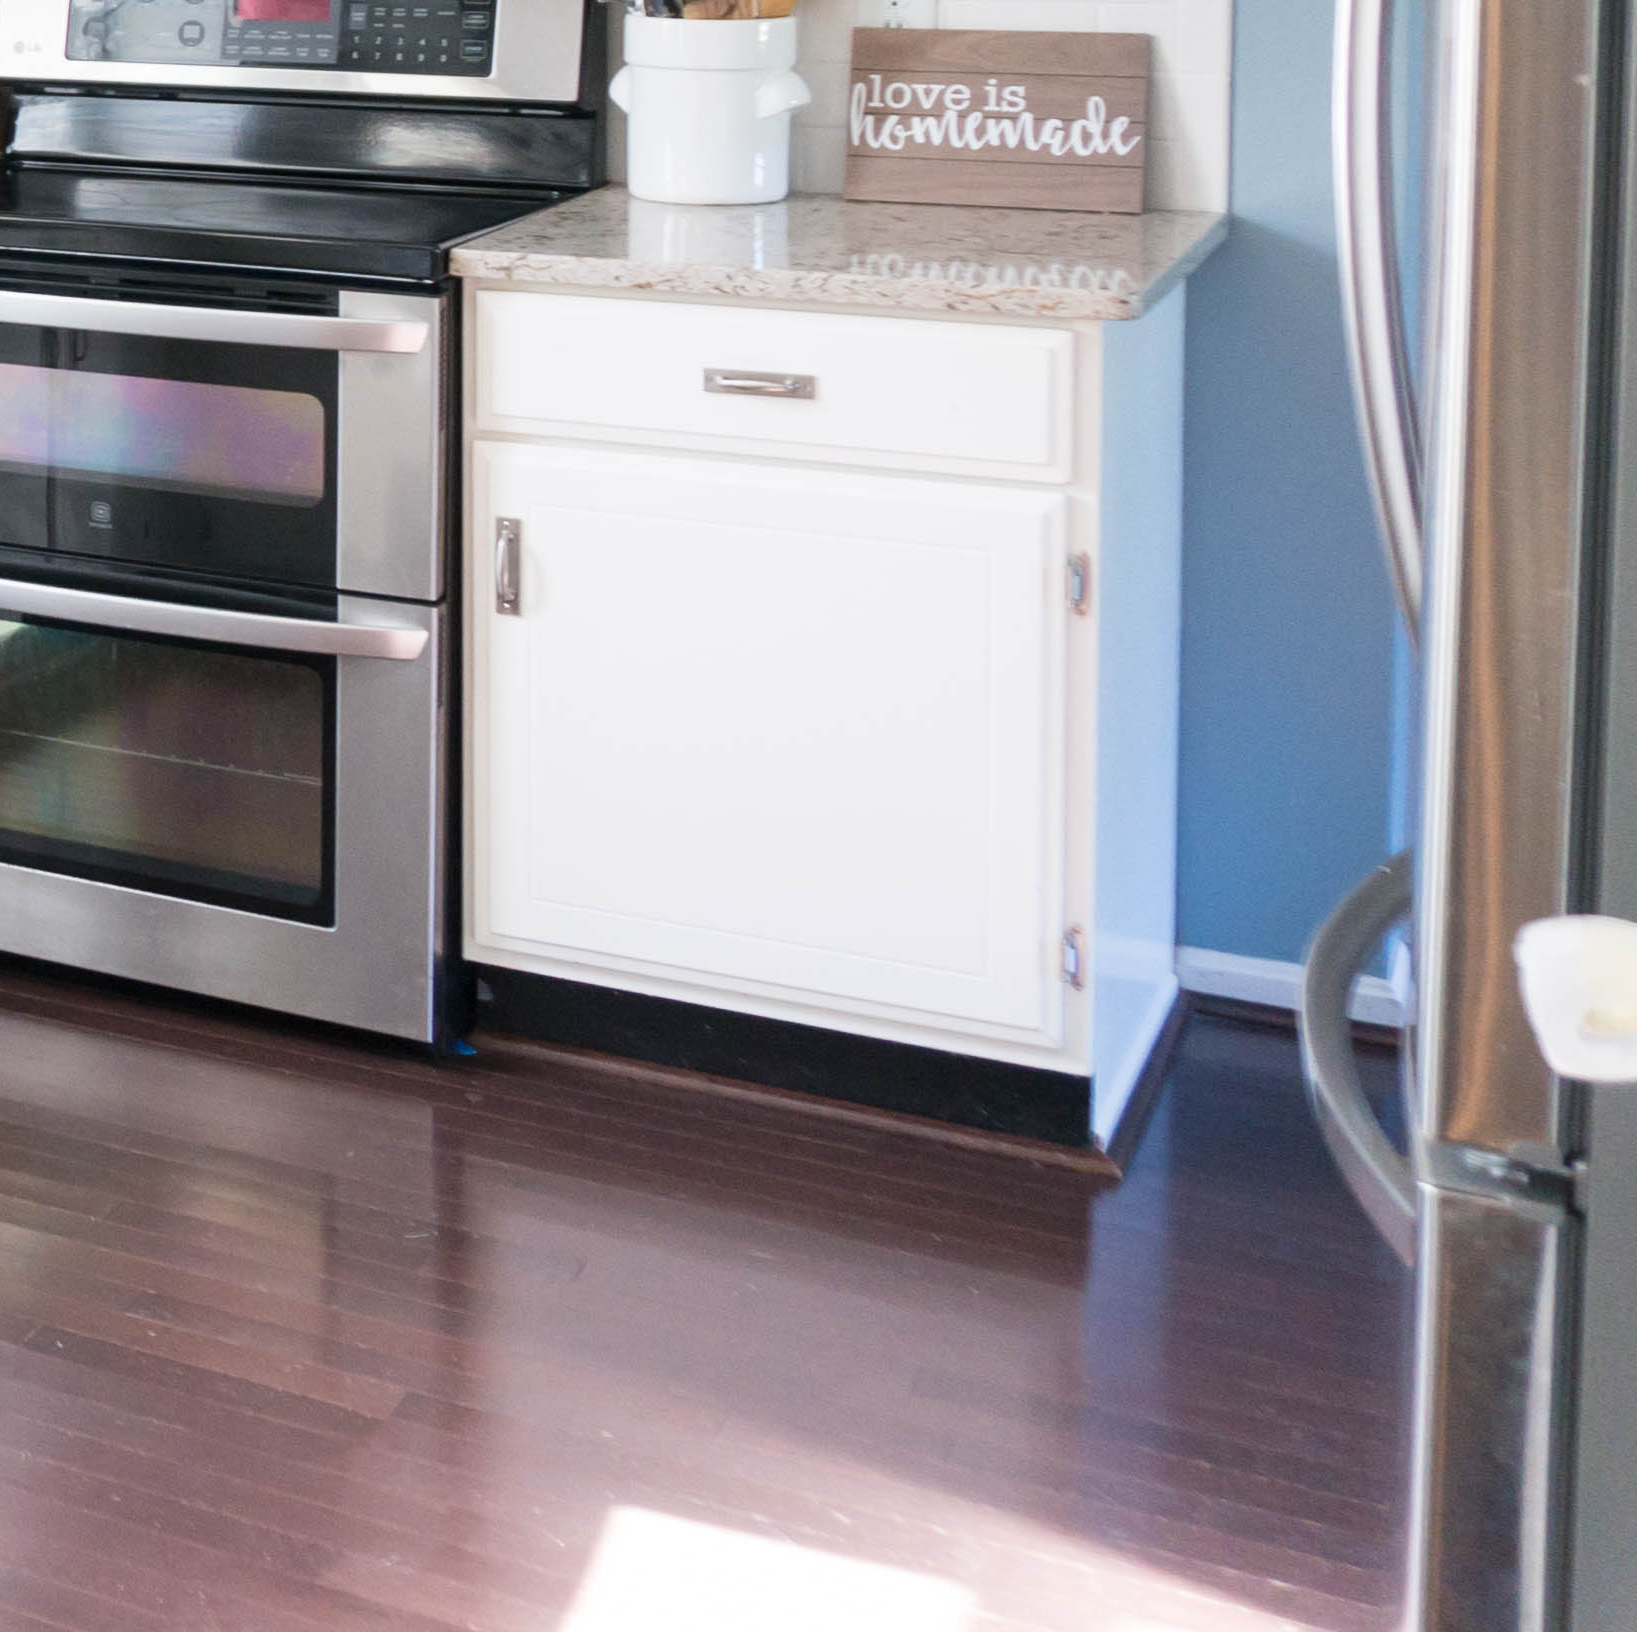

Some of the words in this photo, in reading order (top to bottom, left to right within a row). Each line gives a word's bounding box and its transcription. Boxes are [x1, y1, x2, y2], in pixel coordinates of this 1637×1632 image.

[849, 82, 1142, 157] homemade
[868, 74, 971, 111] love
[982, 78, 1027, 114] is
